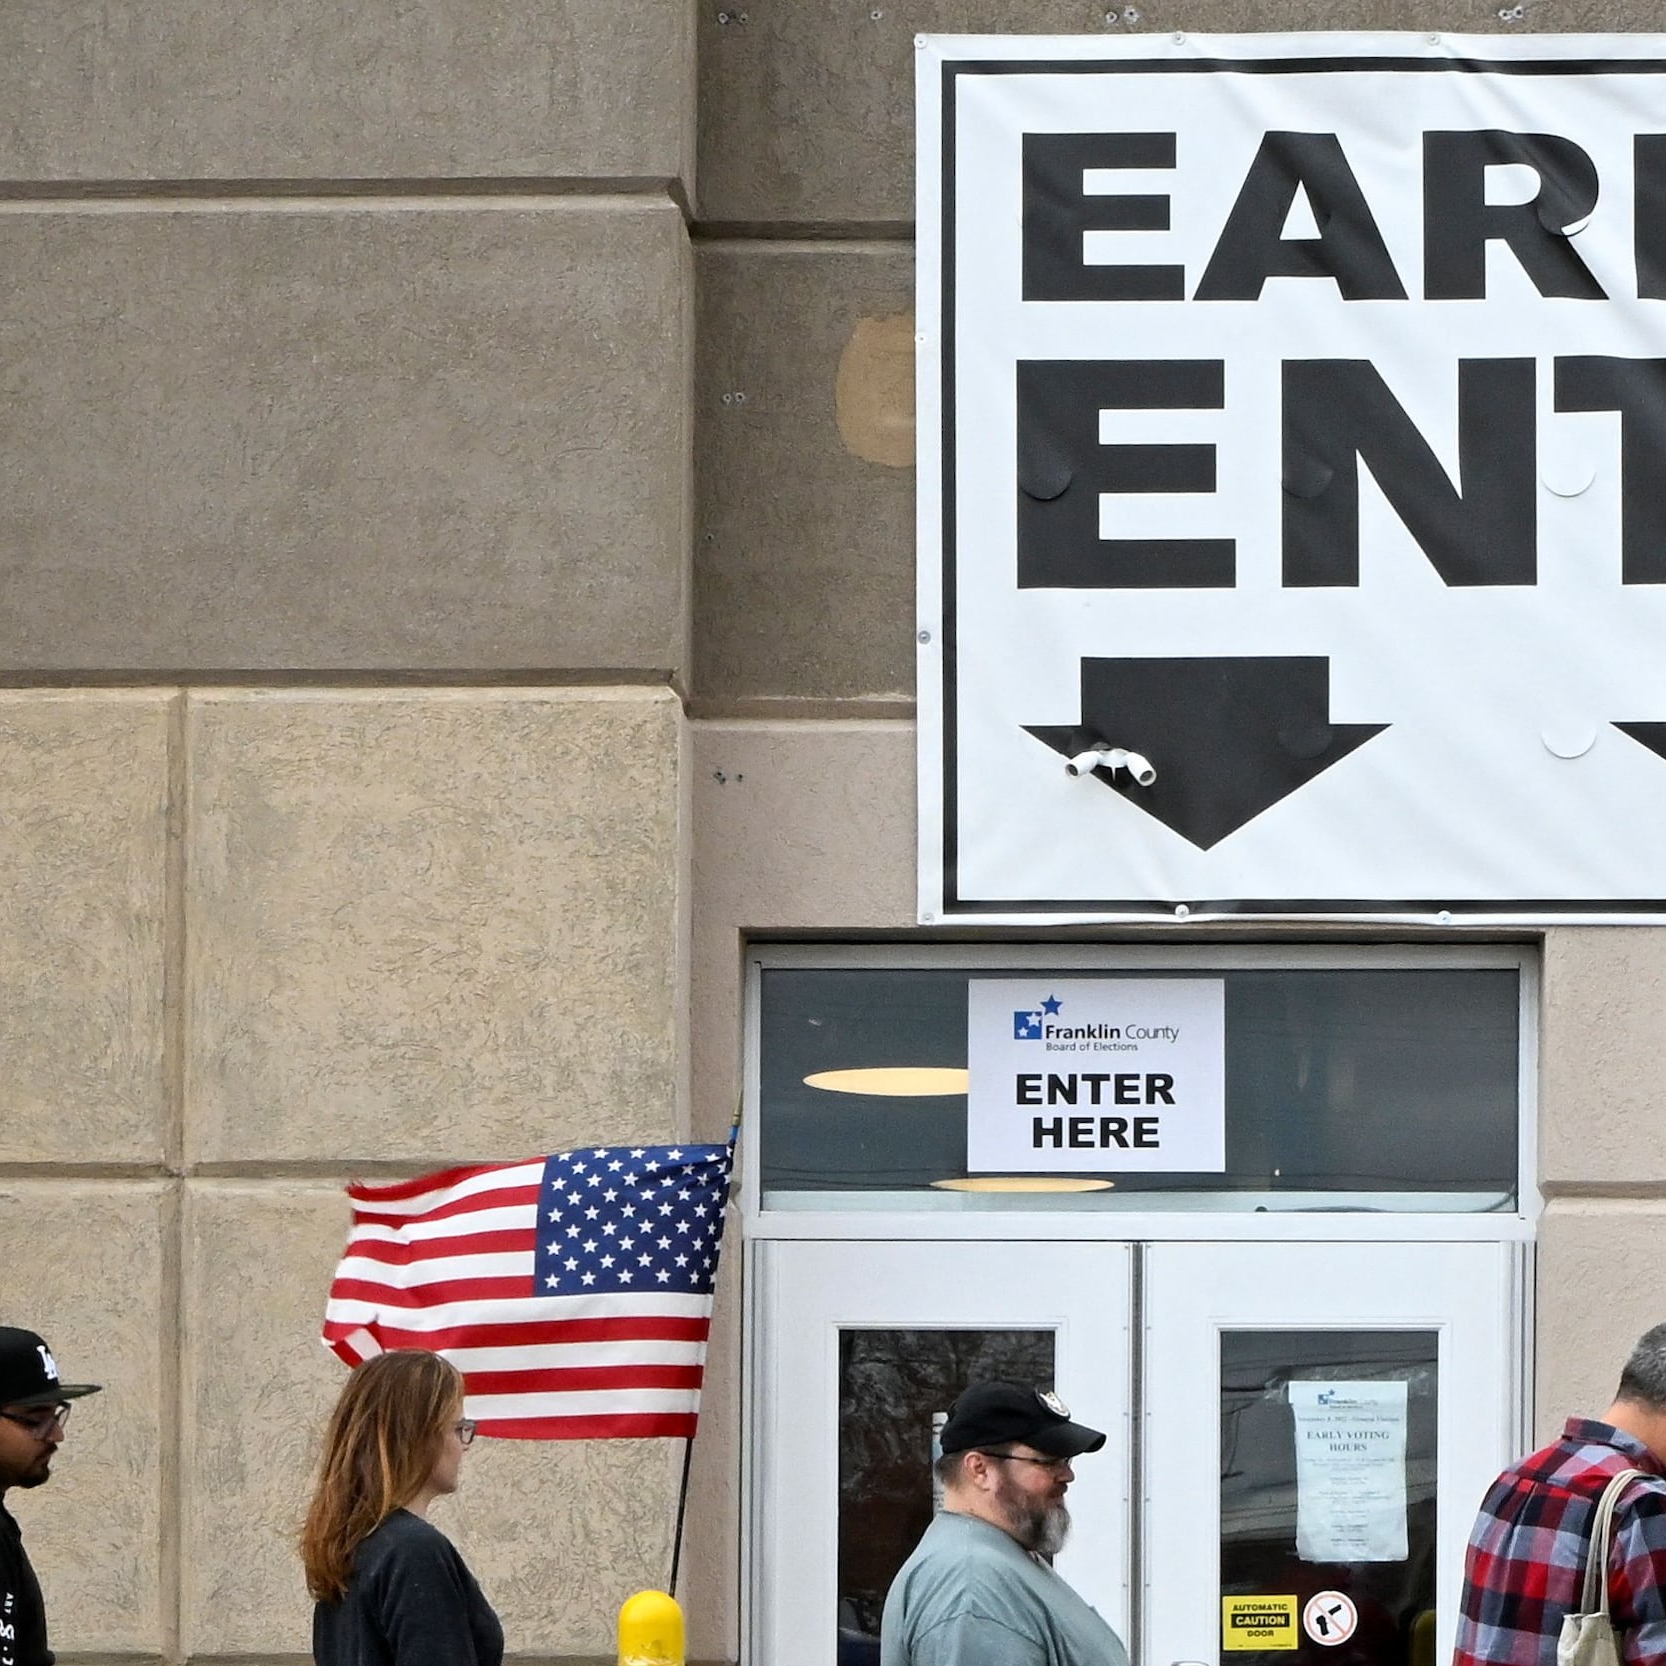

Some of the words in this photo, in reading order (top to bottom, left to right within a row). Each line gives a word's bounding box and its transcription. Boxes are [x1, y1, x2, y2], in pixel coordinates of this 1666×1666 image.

[1045, 1024, 1121, 1040] Franklin
[1125, 1024, 1180, 1044] County
[1045, 1042, 1076, 1052] Board
[1079, 1042, 1091, 1052] of
[1093, 1042, 1139, 1052] Elections
[1015, 1073, 1177, 1106] ENTER
[1032, 1117, 1161, 1149] HERE
[1346, 1431, 1390, 1440] VOTING
[1232, 1603, 1289, 1612] AUTOMATIC
[1235, 1614, 1286, 1626] CAUTION
[1246, 1629, 1275, 1638] DOOR
